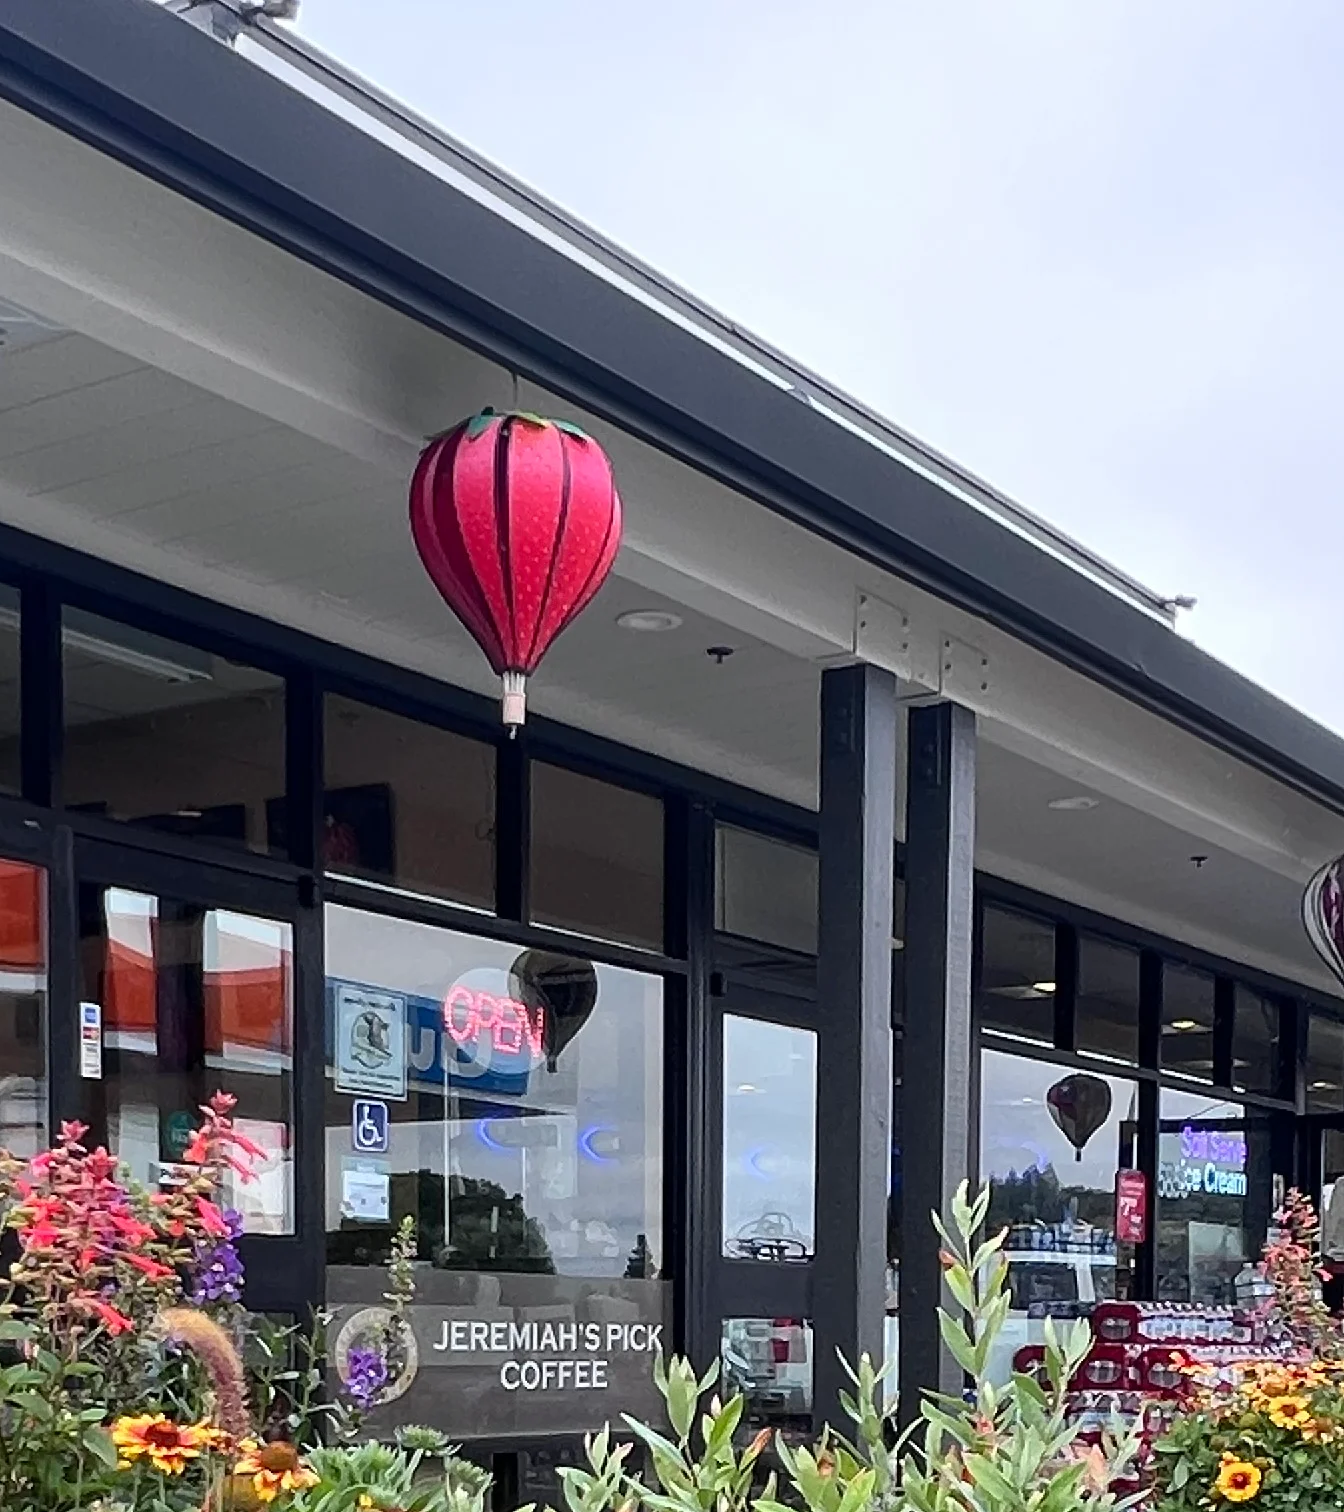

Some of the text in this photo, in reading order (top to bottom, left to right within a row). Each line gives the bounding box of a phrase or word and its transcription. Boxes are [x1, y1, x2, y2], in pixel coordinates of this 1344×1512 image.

[444, 985, 546, 1058] OPEN
[433, 1320, 664, 1352] JEREMIAH'S PICK
[500, 1359, 609, 1390] COFFEE
